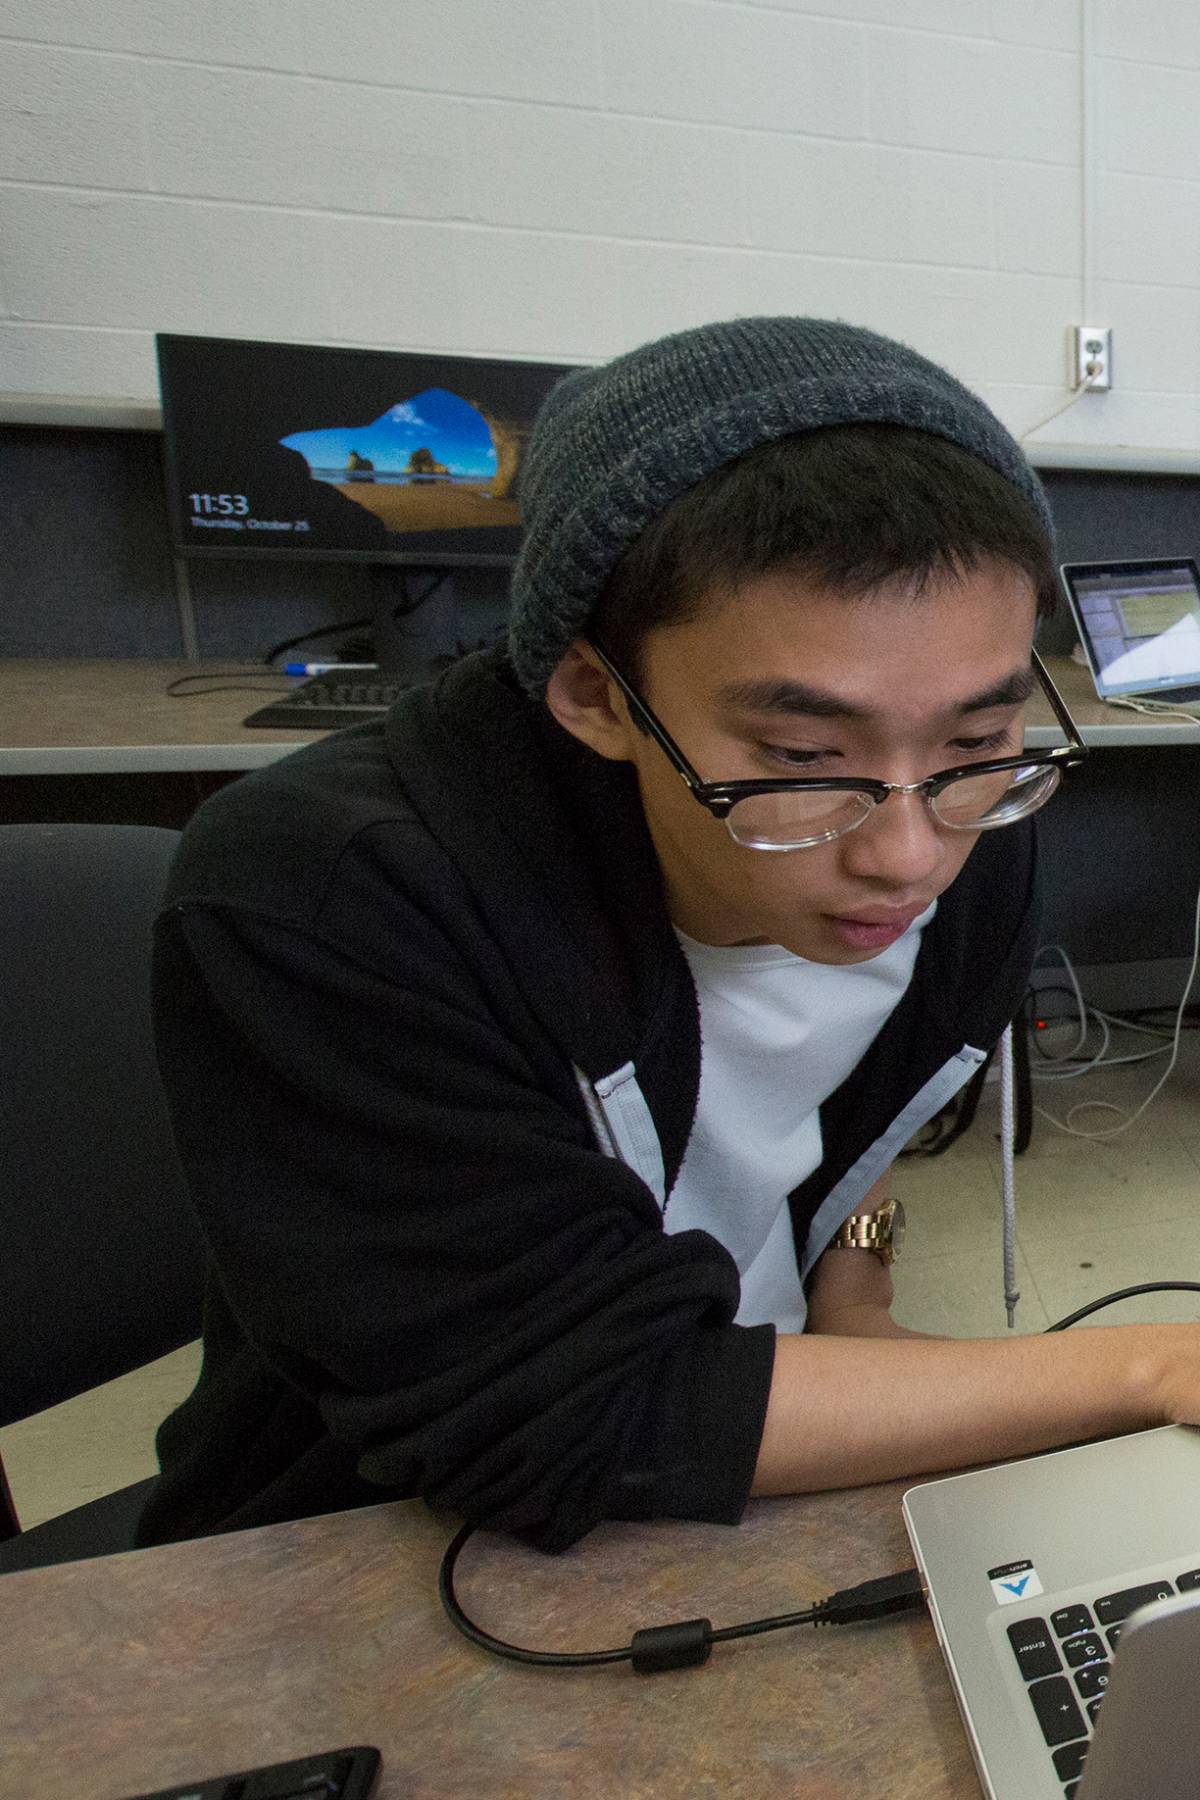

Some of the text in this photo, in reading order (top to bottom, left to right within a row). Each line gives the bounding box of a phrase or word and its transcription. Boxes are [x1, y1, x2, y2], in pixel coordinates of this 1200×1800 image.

[190, 493, 249, 515] 11:53
[1018, 1641, 1046, 1654] Enter
[1084, 1645, 1097, 1656] 3
